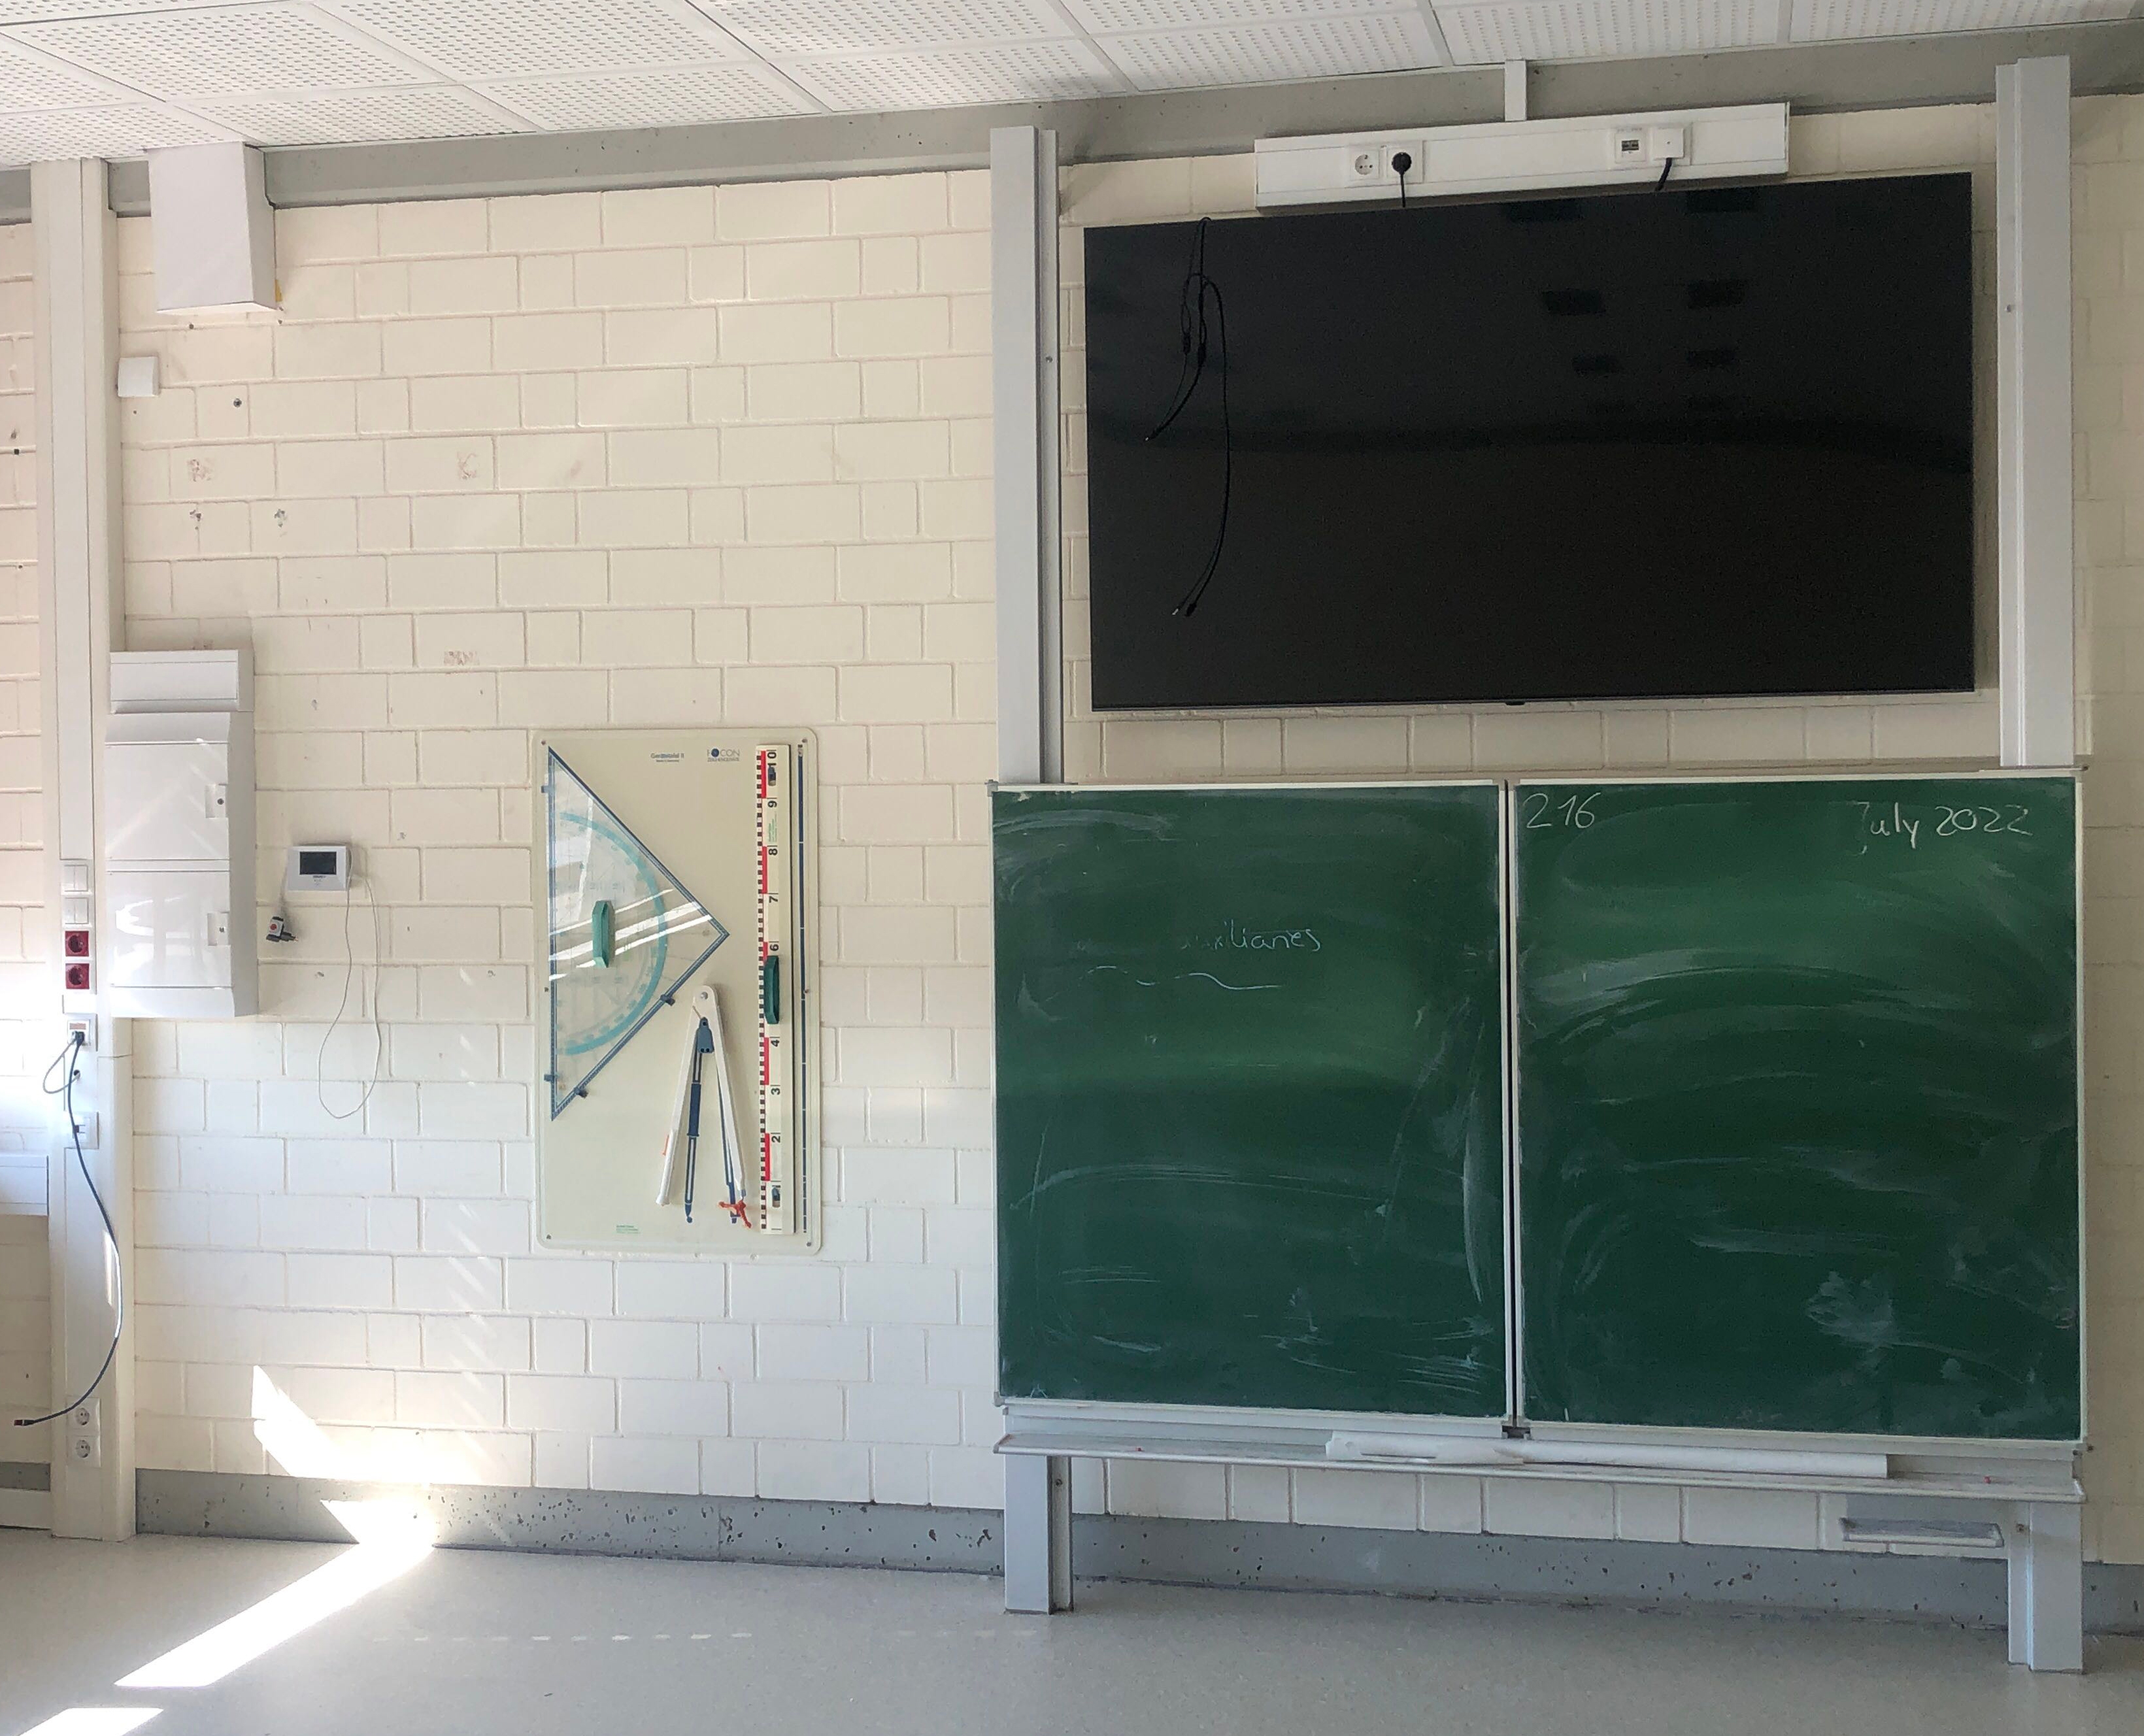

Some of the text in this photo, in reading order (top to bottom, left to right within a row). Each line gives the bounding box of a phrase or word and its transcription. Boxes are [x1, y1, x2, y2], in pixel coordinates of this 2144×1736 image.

[1522, 792, 1601, 829] 216
[1934, 805, 2033, 836] 2022
[768, 848, 778, 856] 8
